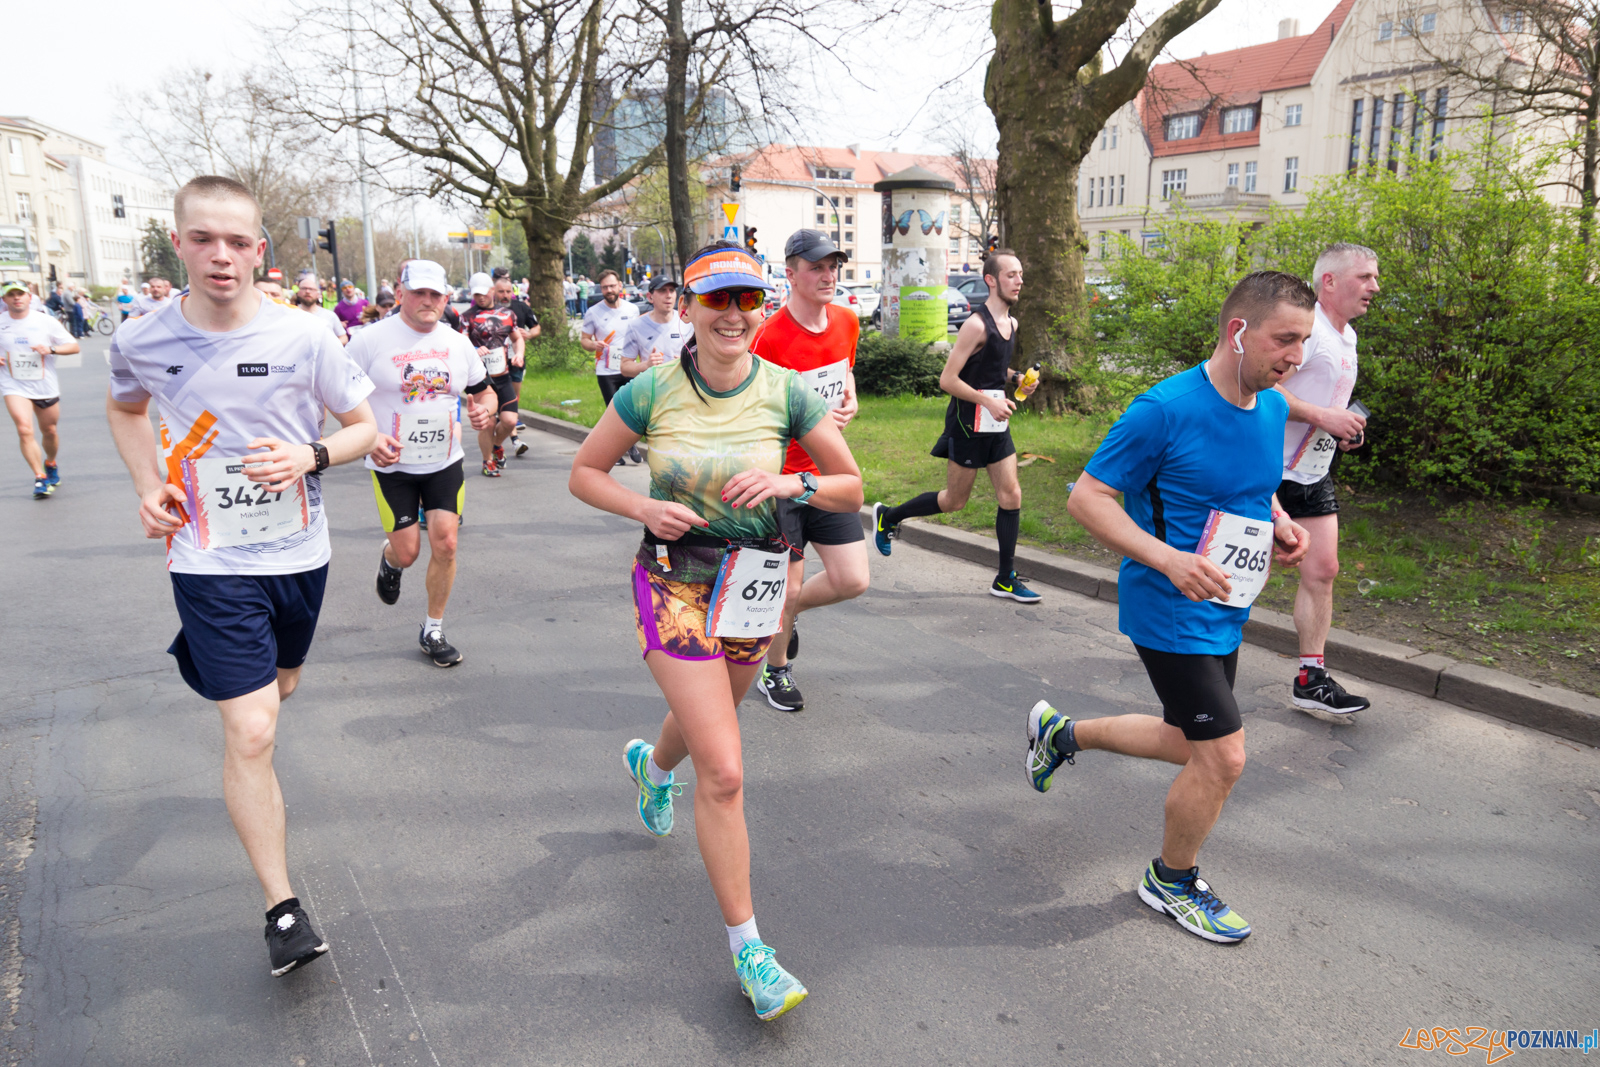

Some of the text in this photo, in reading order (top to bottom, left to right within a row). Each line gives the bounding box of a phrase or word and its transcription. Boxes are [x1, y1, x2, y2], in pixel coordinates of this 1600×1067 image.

[709, 258, 753, 270] IRONMAN
[15, 360, 38, 368] 3774
[166, 365, 184, 375] 4F
[408, 429, 445, 443] 4575
[215, 480, 282, 509] 3427
[1221, 543, 1267, 572] 7865
[741, 577, 786, 601] 6791
